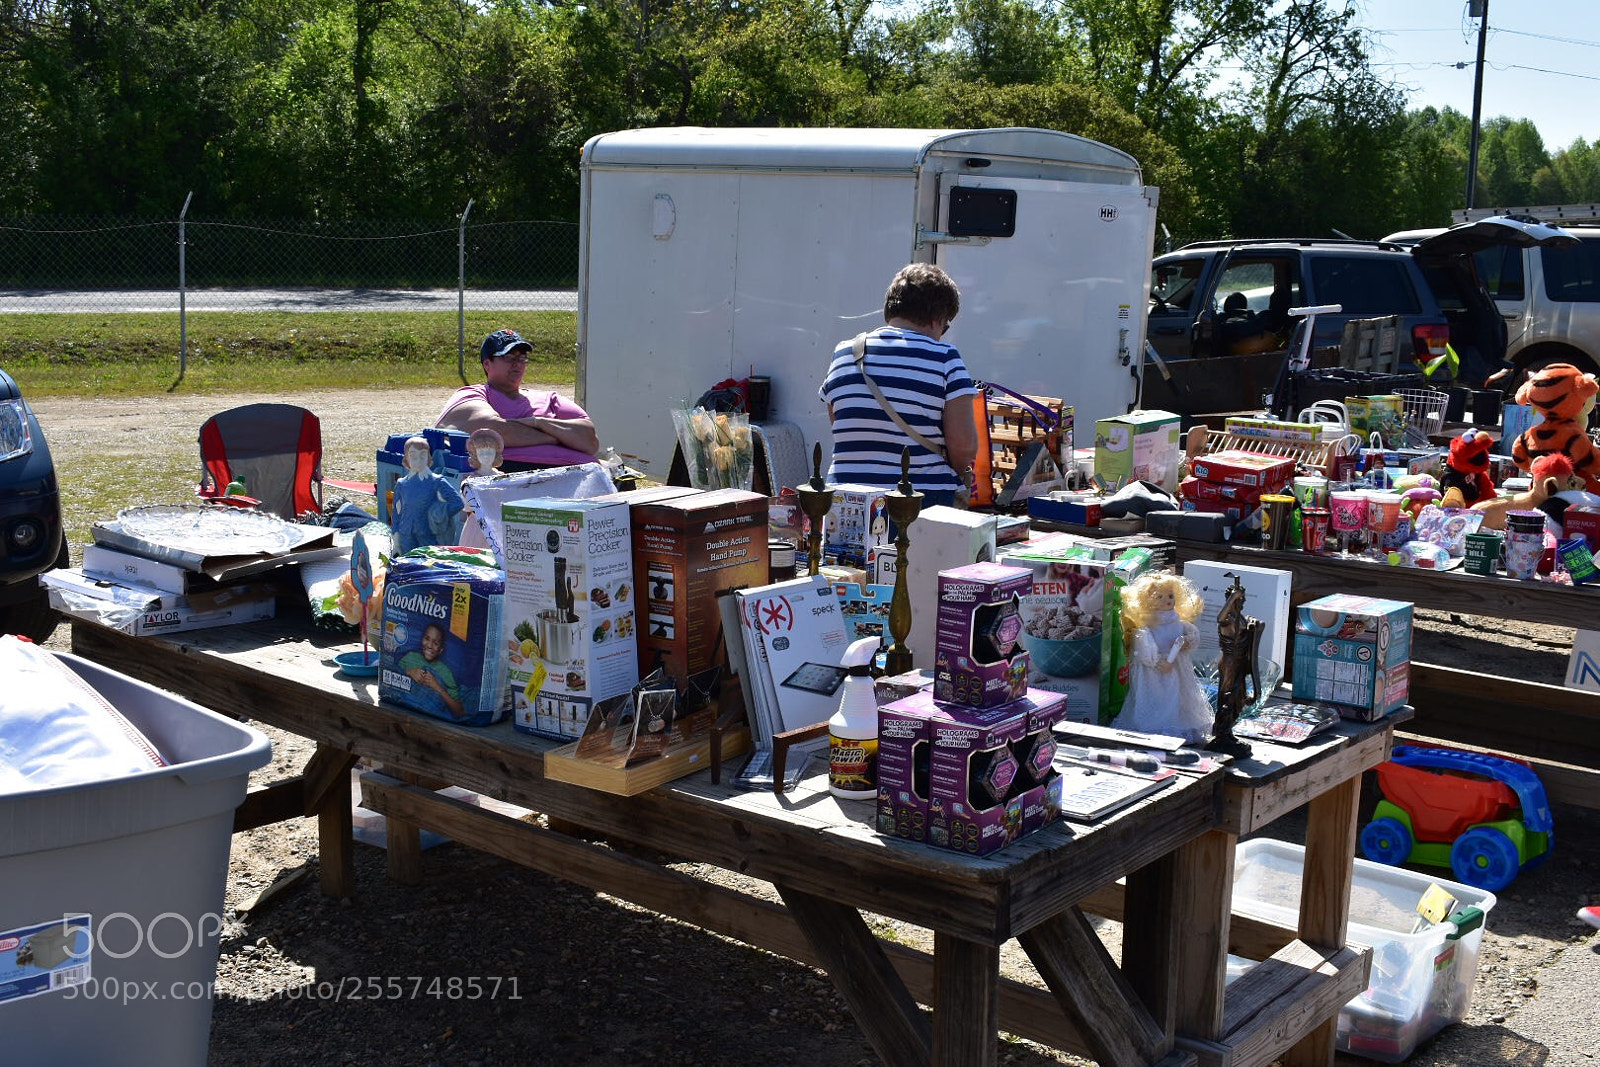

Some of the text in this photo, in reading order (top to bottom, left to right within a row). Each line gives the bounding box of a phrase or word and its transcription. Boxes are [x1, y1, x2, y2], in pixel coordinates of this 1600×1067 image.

[505, 525, 532, 539] Power
[588, 518, 615, 532] Power
[588, 528, 630, 543] Precision
[706, 535, 751, 550] Double Action
[506, 537, 543, 552] Precision
[588, 540, 622, 555] Cooker
[506, 549, 536, 563] Cooker
[710, 548, 748, 562] Hand Pump
[944, 584, 985, 592] HOLOGRAMS
[1032, 582, 1067, 595] ETEN
[387, 587, 448, 619] GoodNites
[811, 603, 835, 616] speck
[144, 611, 179, 623] TAYLOR
[884, 719, 923, 728] HOLOGRAMS
[937, 729, 979, 738] HOLOGRAMS
